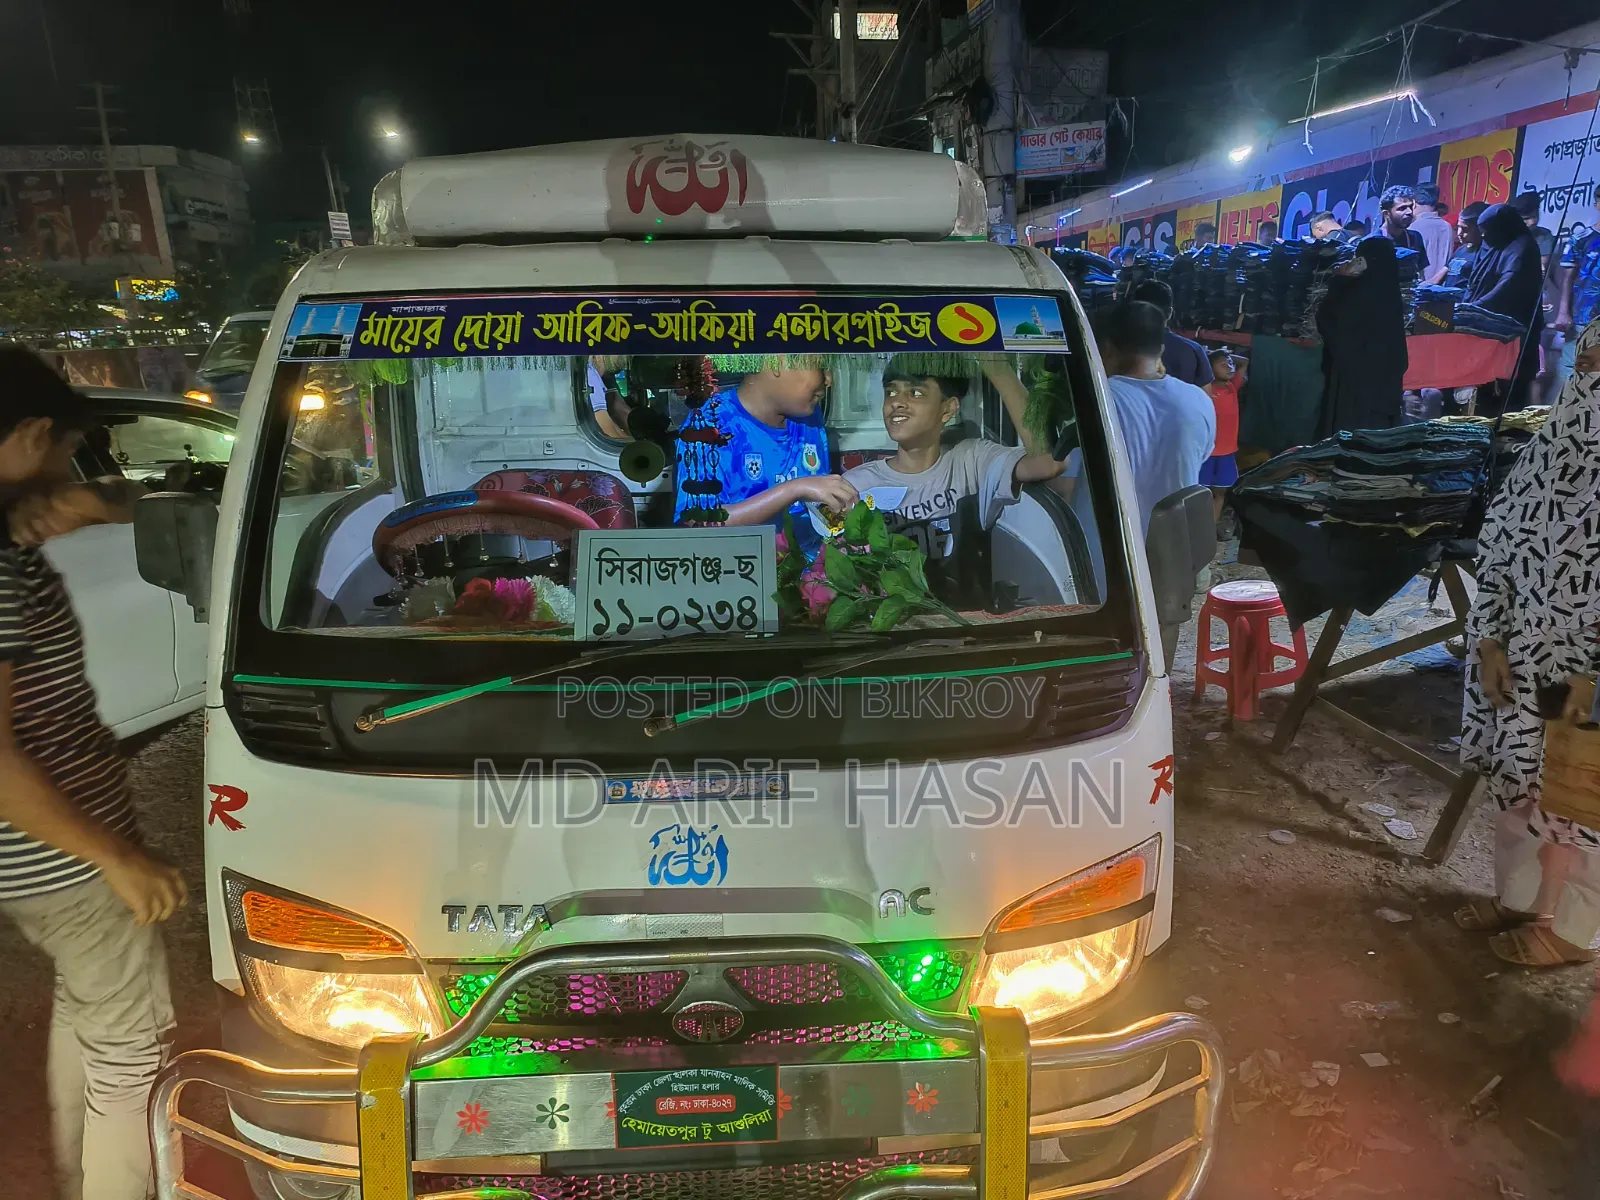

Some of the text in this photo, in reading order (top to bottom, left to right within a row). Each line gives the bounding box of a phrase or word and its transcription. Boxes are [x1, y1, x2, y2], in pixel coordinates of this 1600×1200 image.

[1438, 148, 1516, 216] KIDS
[1220, 201, 1281, 247] IELTS
[359, 311, 446, 353] মায়ের
[453, 311, 524, 350] দোয়া
[766, 303, 938, 348] এন্টারপ্রাইজ
[594, 547, 758, 588] সিরাজগঞ্জ-ছ
[592, 595, 759, 636] ১১-০২৩৪
[442, 904, 553, 934] TATA
[621, 1108, 773, 1141] হেমায়েতপুর টু আশুলিয়া
